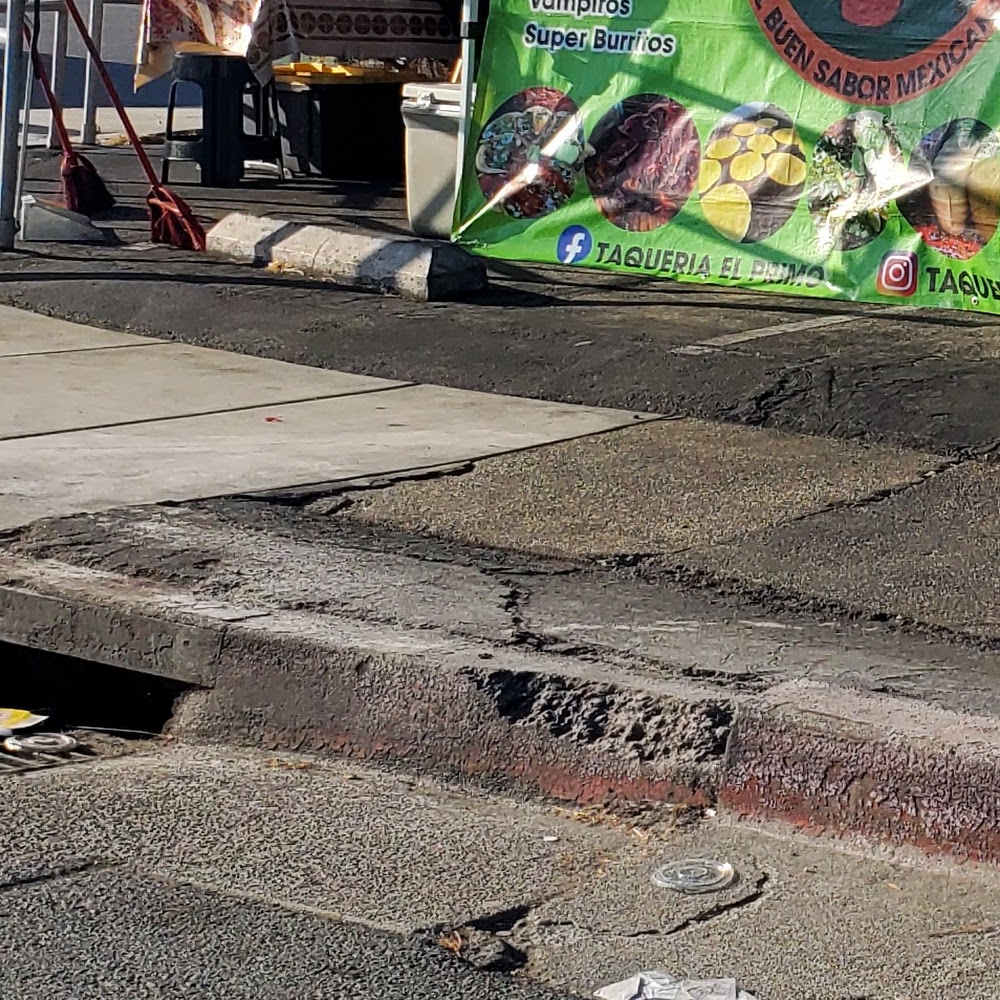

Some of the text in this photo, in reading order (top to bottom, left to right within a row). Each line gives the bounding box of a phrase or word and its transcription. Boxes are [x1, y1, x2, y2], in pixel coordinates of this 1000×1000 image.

[524, 22, 587, 50] Super
[763, 6, 814, 72] BUEN
[813, 59, 891, 100] SABOR
[596, 240, 711, 277] TAQUERIA
[719, 256, 742, 281] EL
